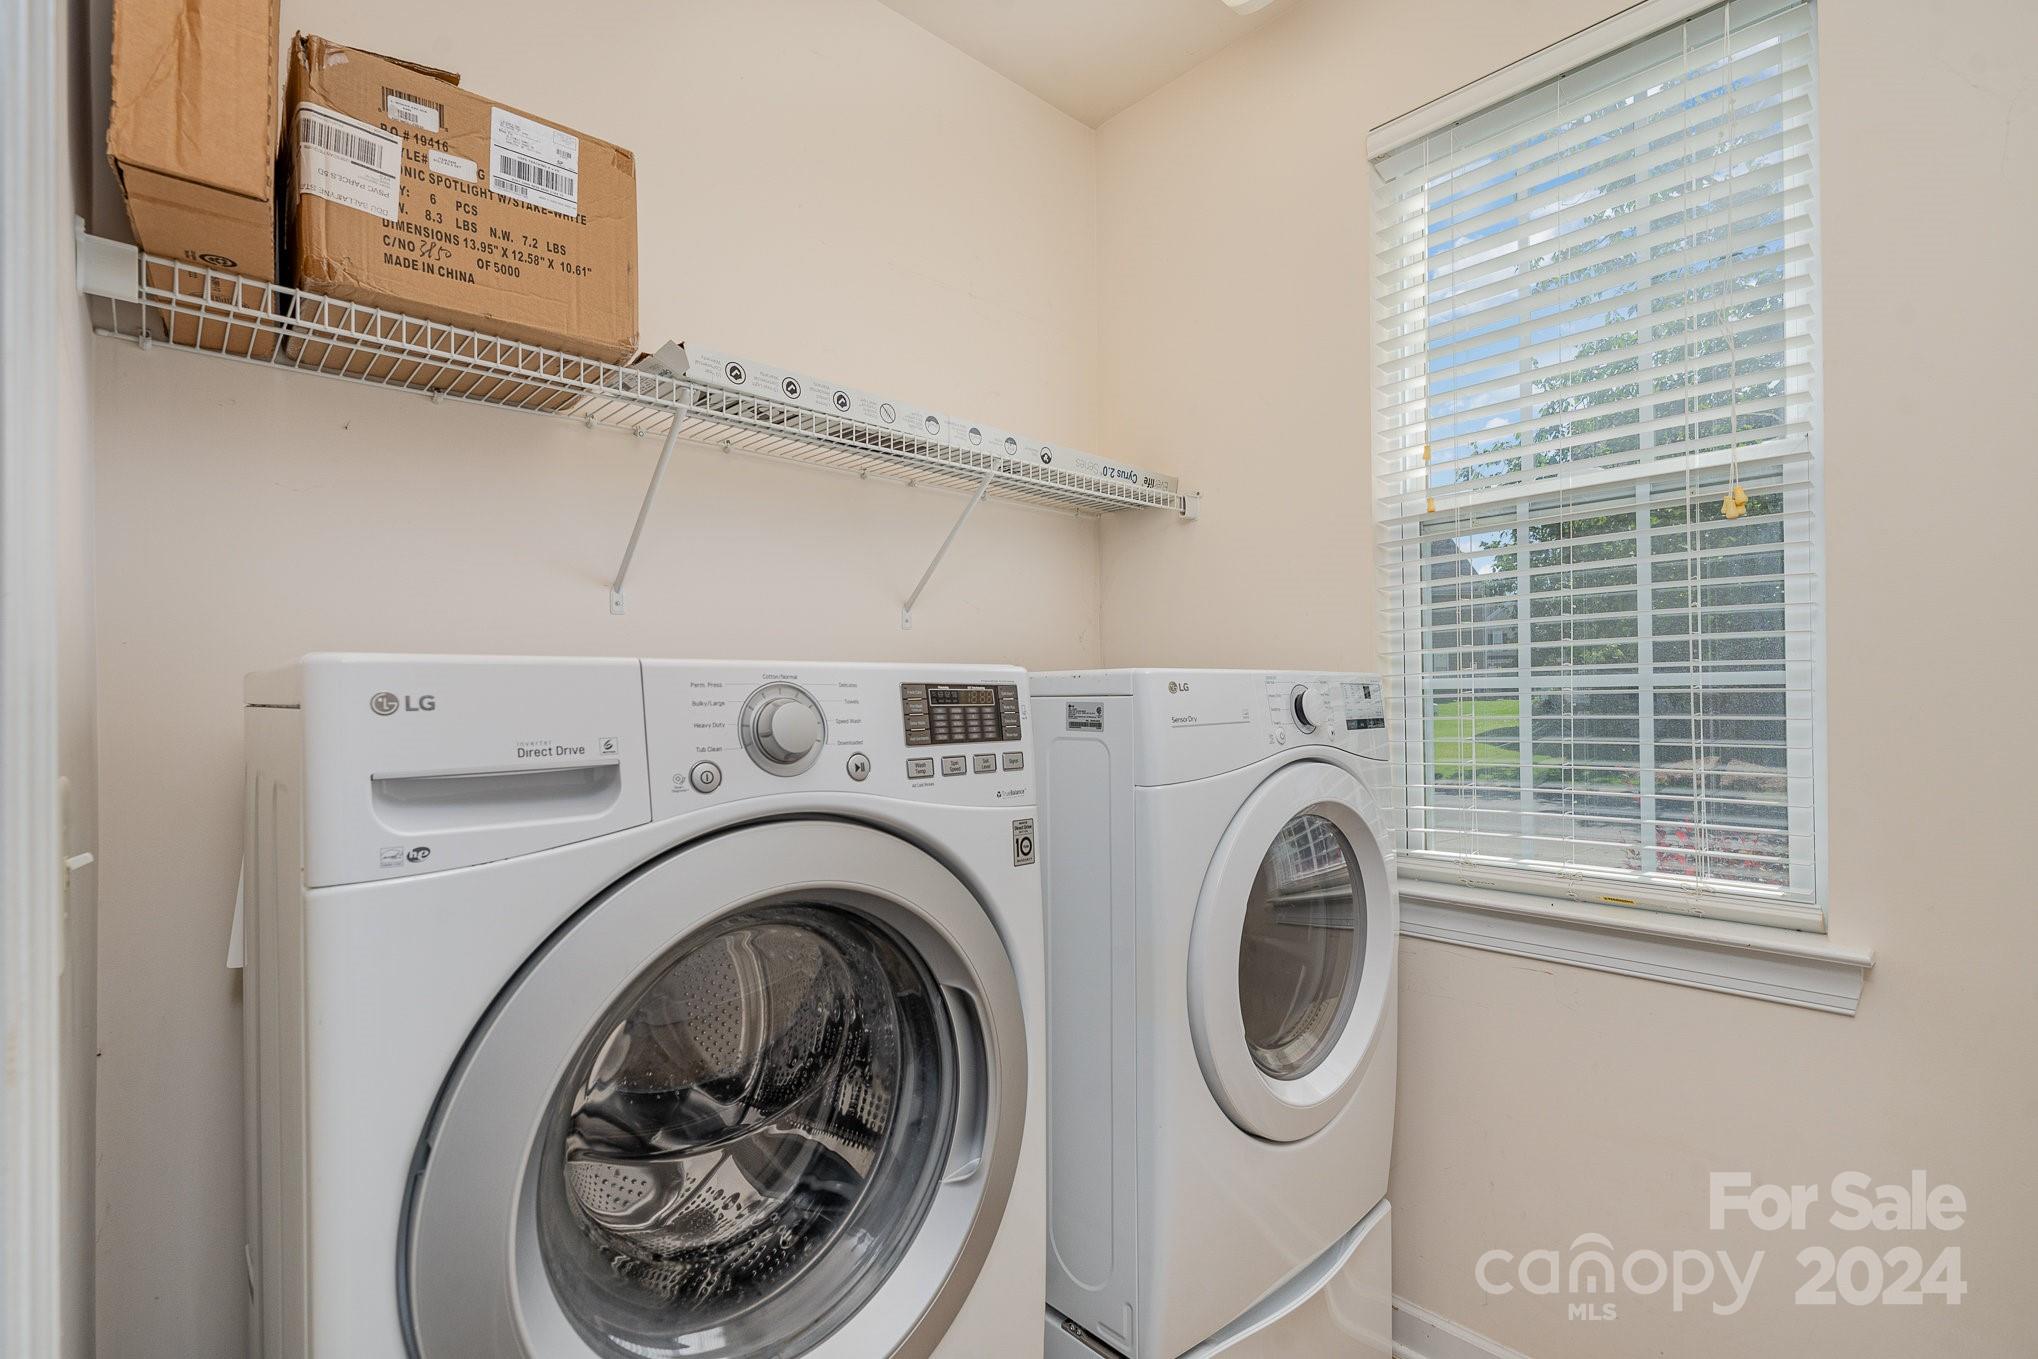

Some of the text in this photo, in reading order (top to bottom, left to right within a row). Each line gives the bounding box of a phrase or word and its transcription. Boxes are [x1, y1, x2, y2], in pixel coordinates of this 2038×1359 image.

[413, 134, 449, 152] 19416
[429, 173, 494, 200] SPOTLIGHT
[429, 194, 437, 204] 6
[456, 201, 478, 216] PCS
[425, 210, 443, 224] 8.3
[456, 218, 478, 233] LBS
[489, 226, 514, 243] N.W.
[522, 236, 538, 249] 7.2
[546, 241, 566, 256] LBS
[382, 218, 592, 277] DIMENSIONS 13.95" X 12.58" X 10.61"
[383, 234, 415, 252] C/NO
[383, 252, 475, 285] MADE IN CHINA
[476, 258, 520, 278] OF 5000
[1102, 465, 1115, 479] 2.0
[1116, 469, 1138, 484] Cyrus
[1178, 682, 1190, 692] LG
[405, 695, 436, 711] LG
[691, 700, 726, 708] Bulky/Large
[517, 745, 586, 758] Direct Drive
[1015, 836, 1033, 858] 10
